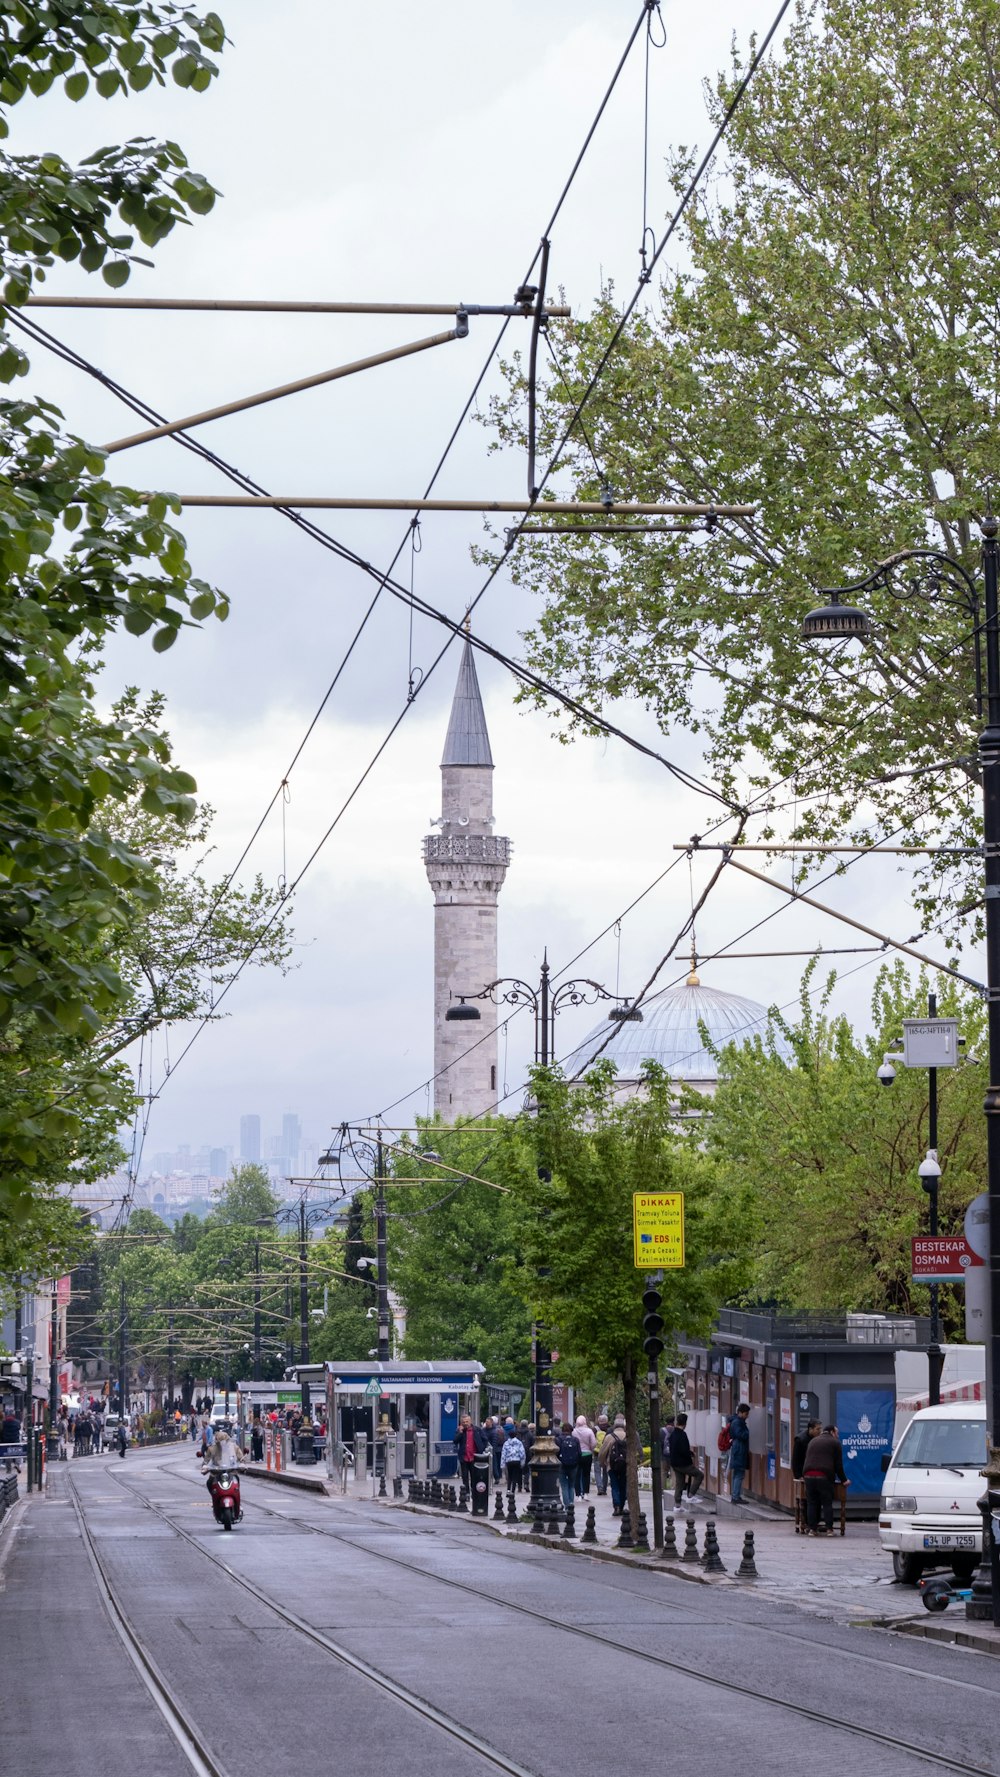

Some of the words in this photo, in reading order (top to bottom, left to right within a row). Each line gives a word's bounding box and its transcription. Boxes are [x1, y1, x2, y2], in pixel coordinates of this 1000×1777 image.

[640, 1198, 676, 1207] DİKKAT
[638, 1209, 660, 1218] Tramvay
[654, 1234, 670, 1243] EDS
[672, 1234, 680, 1243] ile
[914, 1241, 966, 1252] BESTEKAR
[914, 1254, 950, 1265] OSMAN
[842, 1436, 888, 1446] BÜYÜKŞEHİR
[929, 1536, 938, 1545] 34
[941, 1536, 951, 1544] UP
[956, 1536, 973, 1545] 1255
